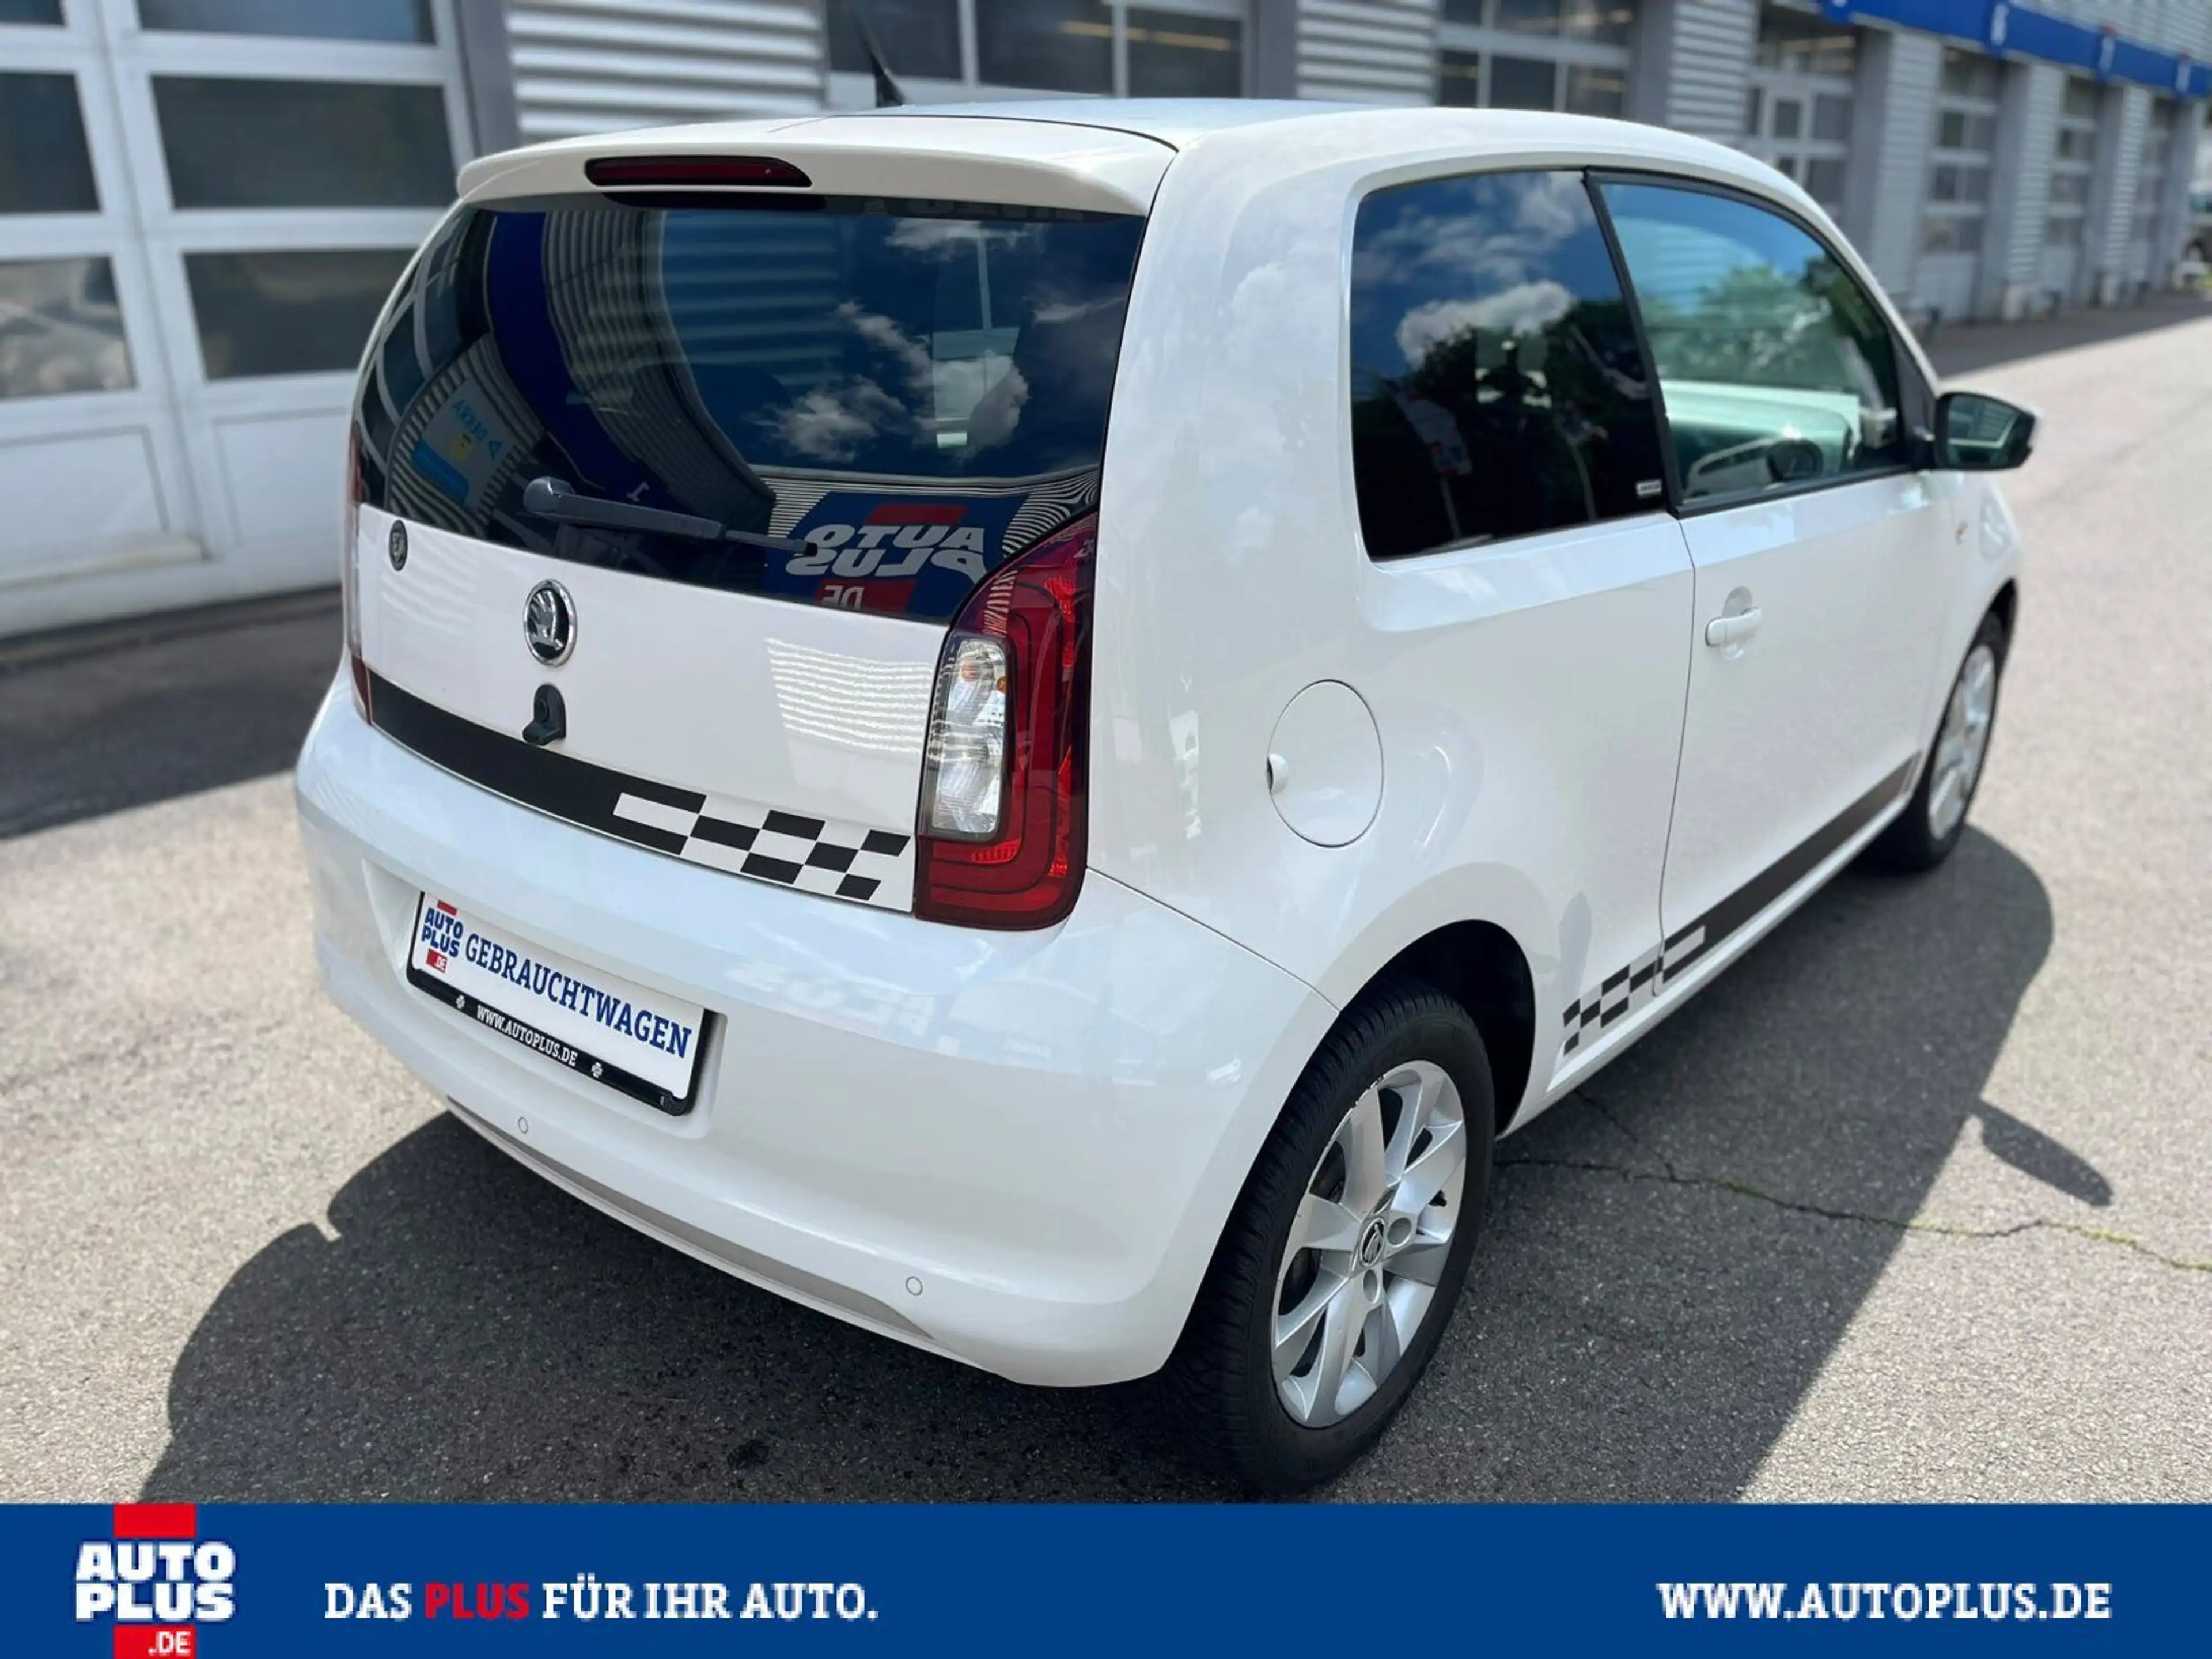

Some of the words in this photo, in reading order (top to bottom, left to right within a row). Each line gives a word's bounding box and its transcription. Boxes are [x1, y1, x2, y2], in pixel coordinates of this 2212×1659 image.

[421, 925, 460, 957] PLUS
[425, 907, 464, 940] AUTO
[465, 933, 692, 1058] GEBRAUCHTWAGEN
[476, 1004, 578, 1067] WWW.AUTOPLUS.DE
